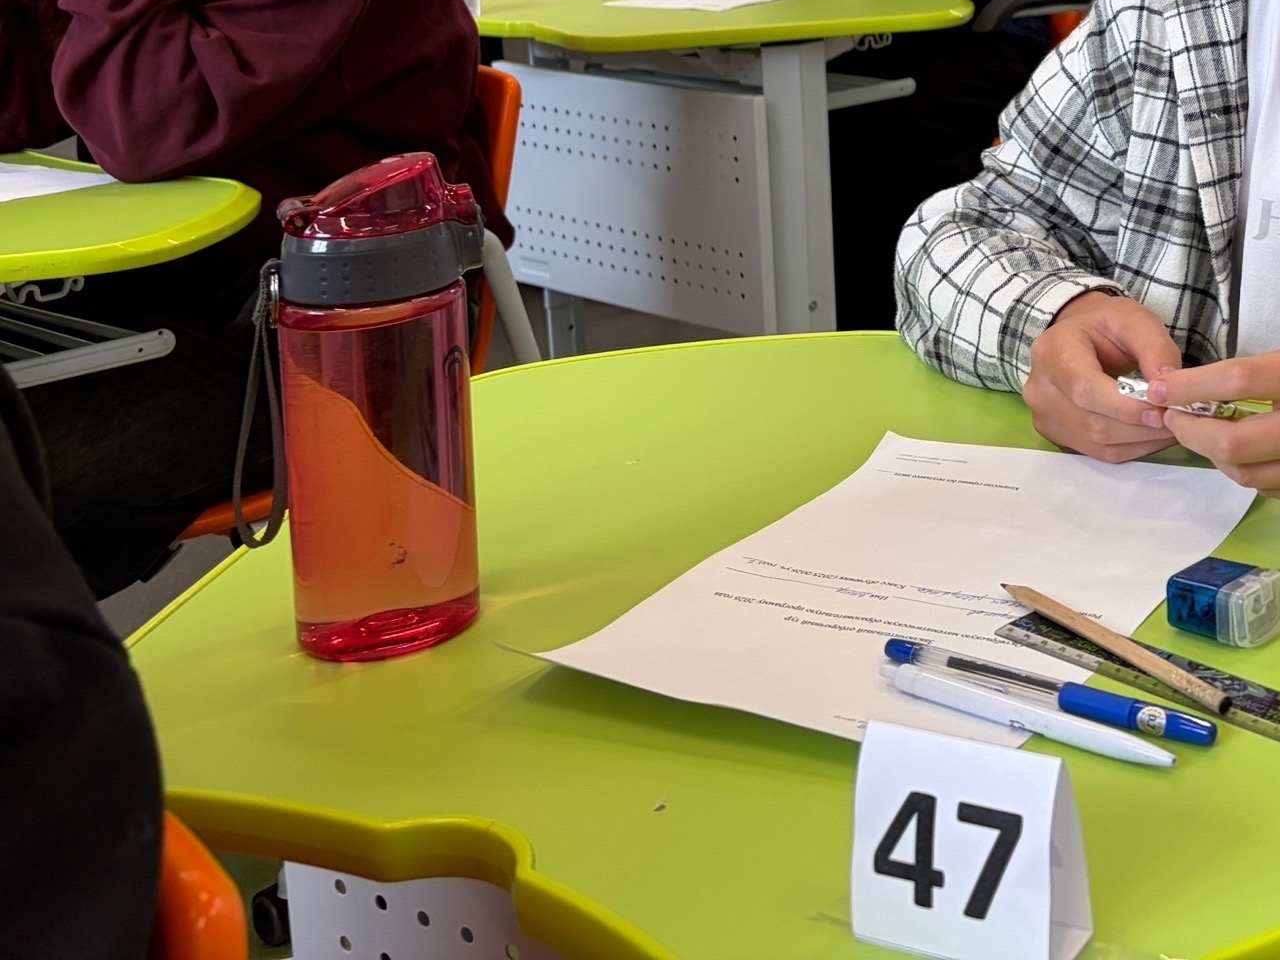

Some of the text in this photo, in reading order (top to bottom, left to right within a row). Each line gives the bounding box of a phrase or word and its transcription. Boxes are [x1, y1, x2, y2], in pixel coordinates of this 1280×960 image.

[714, 591, 734, 599] года
[756, 599, 805, 612] программу
[806, 608, 882, 626] образовательную
[784, 615, 934, 645] Заключительный отборочный тур
[883, 621, 959, 637] математическую
[872, 789, 1023, 921] 47
